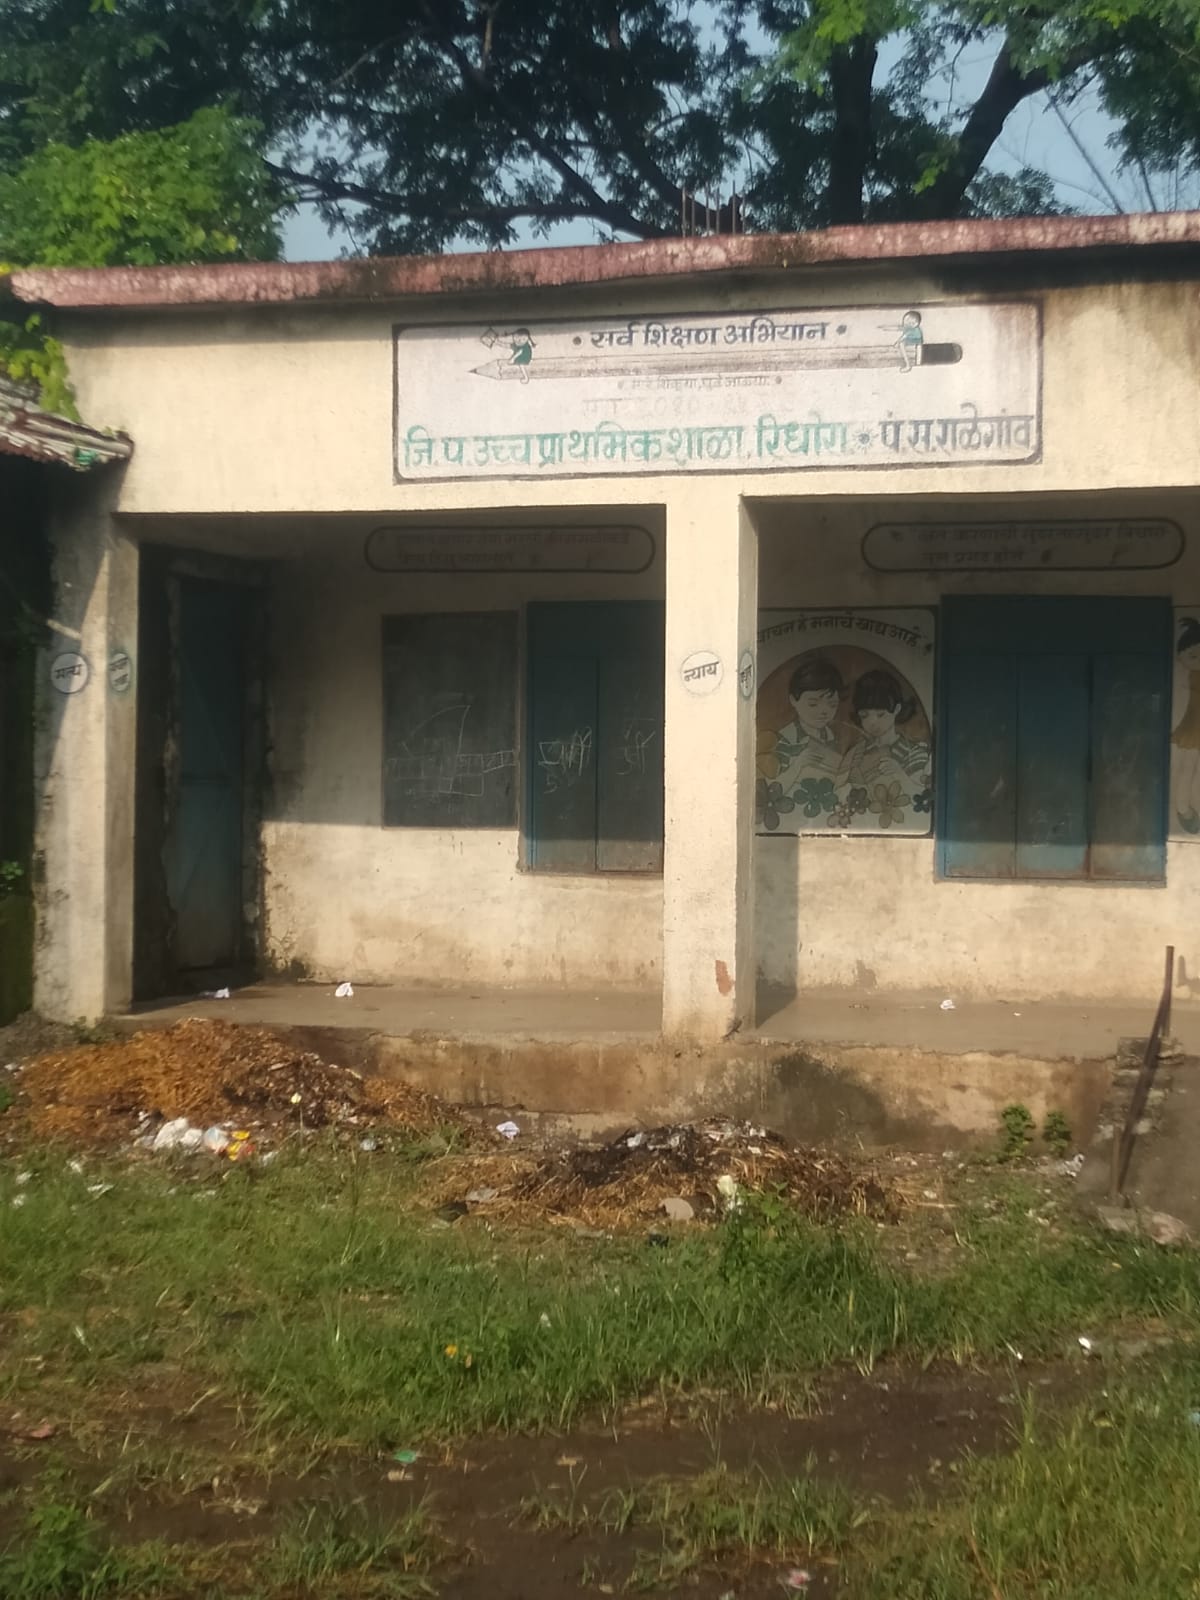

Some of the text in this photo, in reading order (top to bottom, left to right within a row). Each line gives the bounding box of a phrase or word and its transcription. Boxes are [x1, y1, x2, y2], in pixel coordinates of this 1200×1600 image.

[590, 317, 829, 349] सर्व शिक्षण अभियान
[535, 420, 666, 468] प्राथमिक
[683, 661, 720, 683] न्याय
